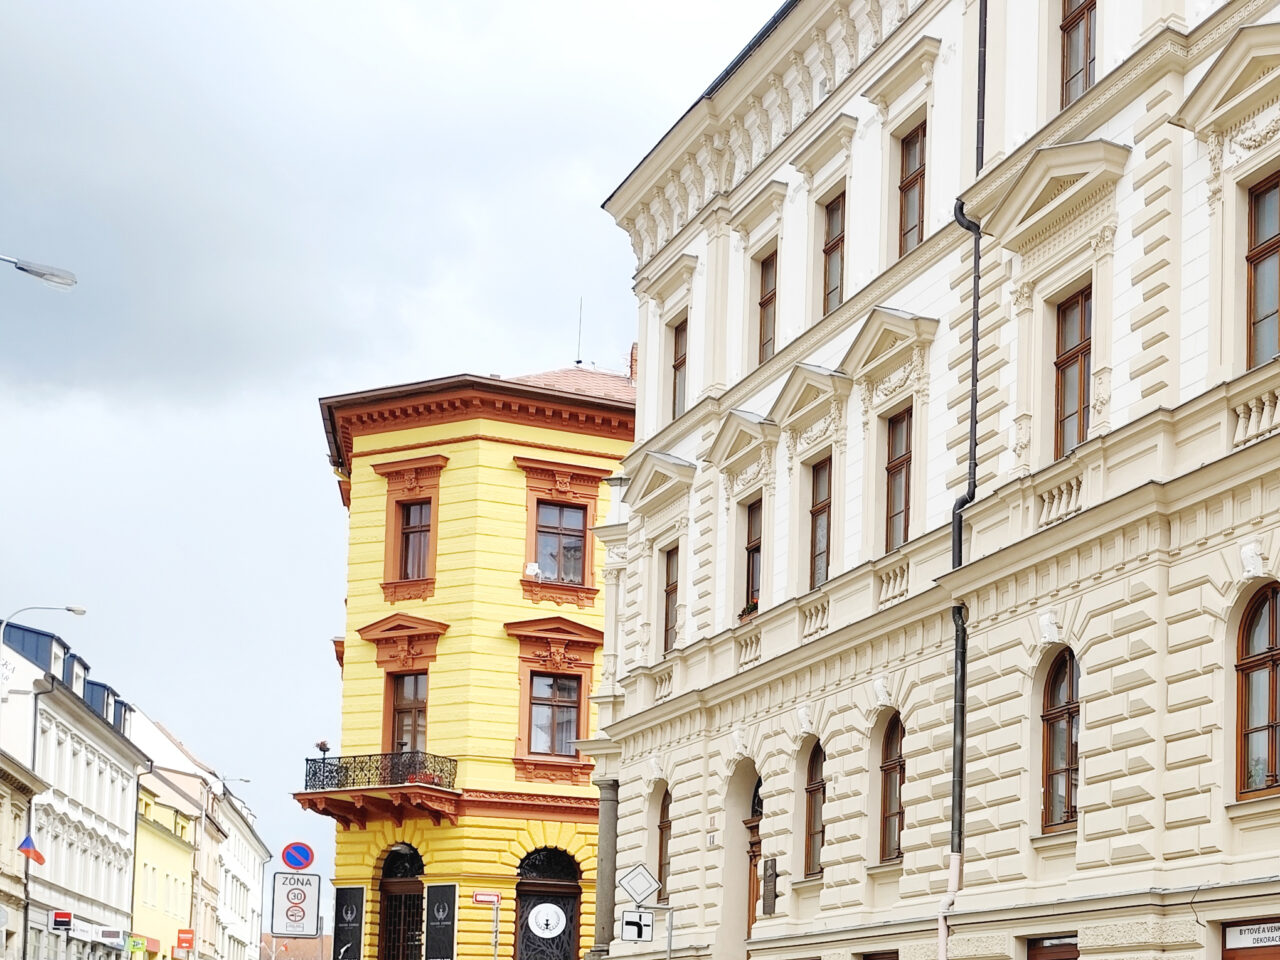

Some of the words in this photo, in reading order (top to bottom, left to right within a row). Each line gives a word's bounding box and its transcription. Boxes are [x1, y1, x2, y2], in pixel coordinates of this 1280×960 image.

[282, 875, 312, 887] ZÓNA
[290, 892, 303, 901] 30
[1239, 926, 1261, 936] BYTOVÉ
